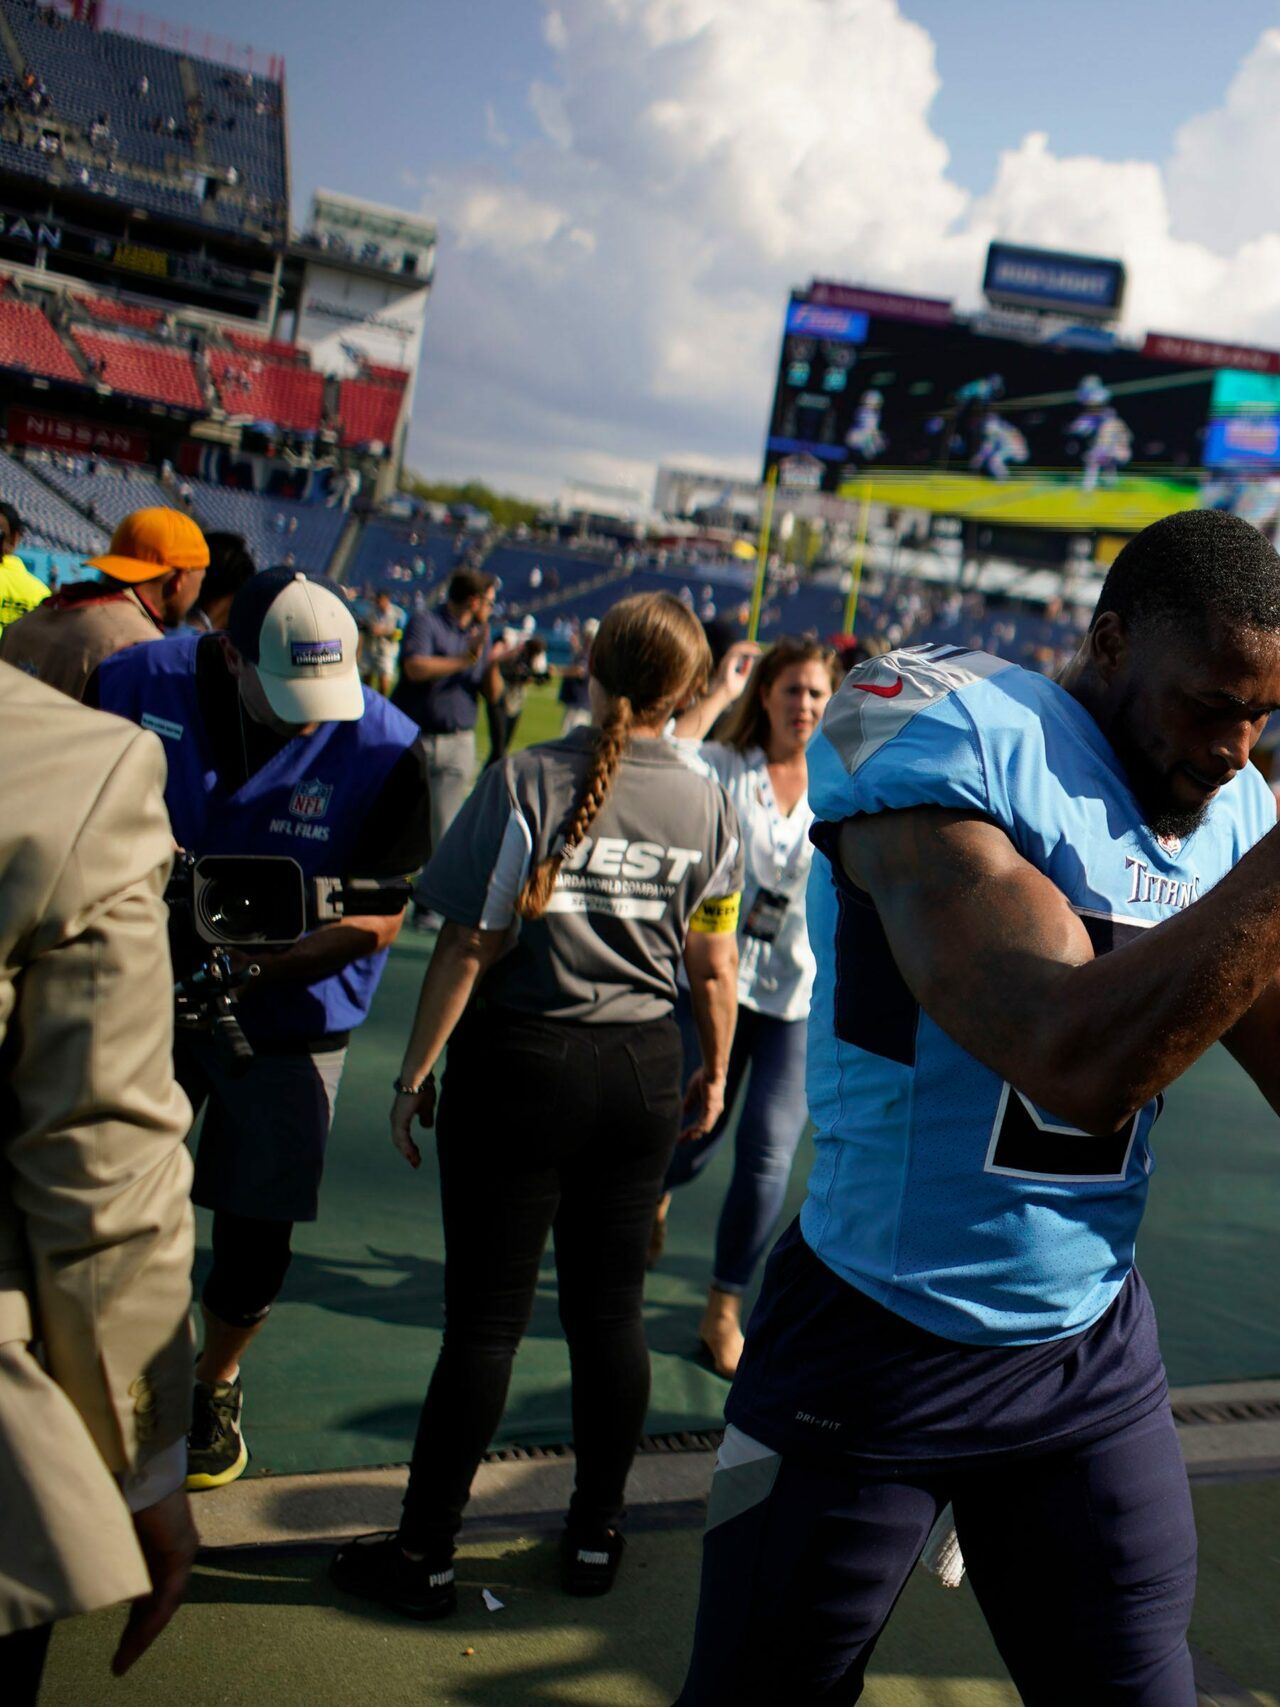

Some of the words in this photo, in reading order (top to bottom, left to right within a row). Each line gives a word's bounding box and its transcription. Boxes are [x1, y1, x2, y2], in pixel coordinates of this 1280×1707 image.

[26, 415, 131, 452] NISSAN
[295, 793, 323, 816] NFL
[269, 818, 292, 835] NFL
[295, 821, 330, 842] FILMS
[795, 1410, 841, 1430] DRI-FIT
[577, 1550, 609, 1565] PUMA
